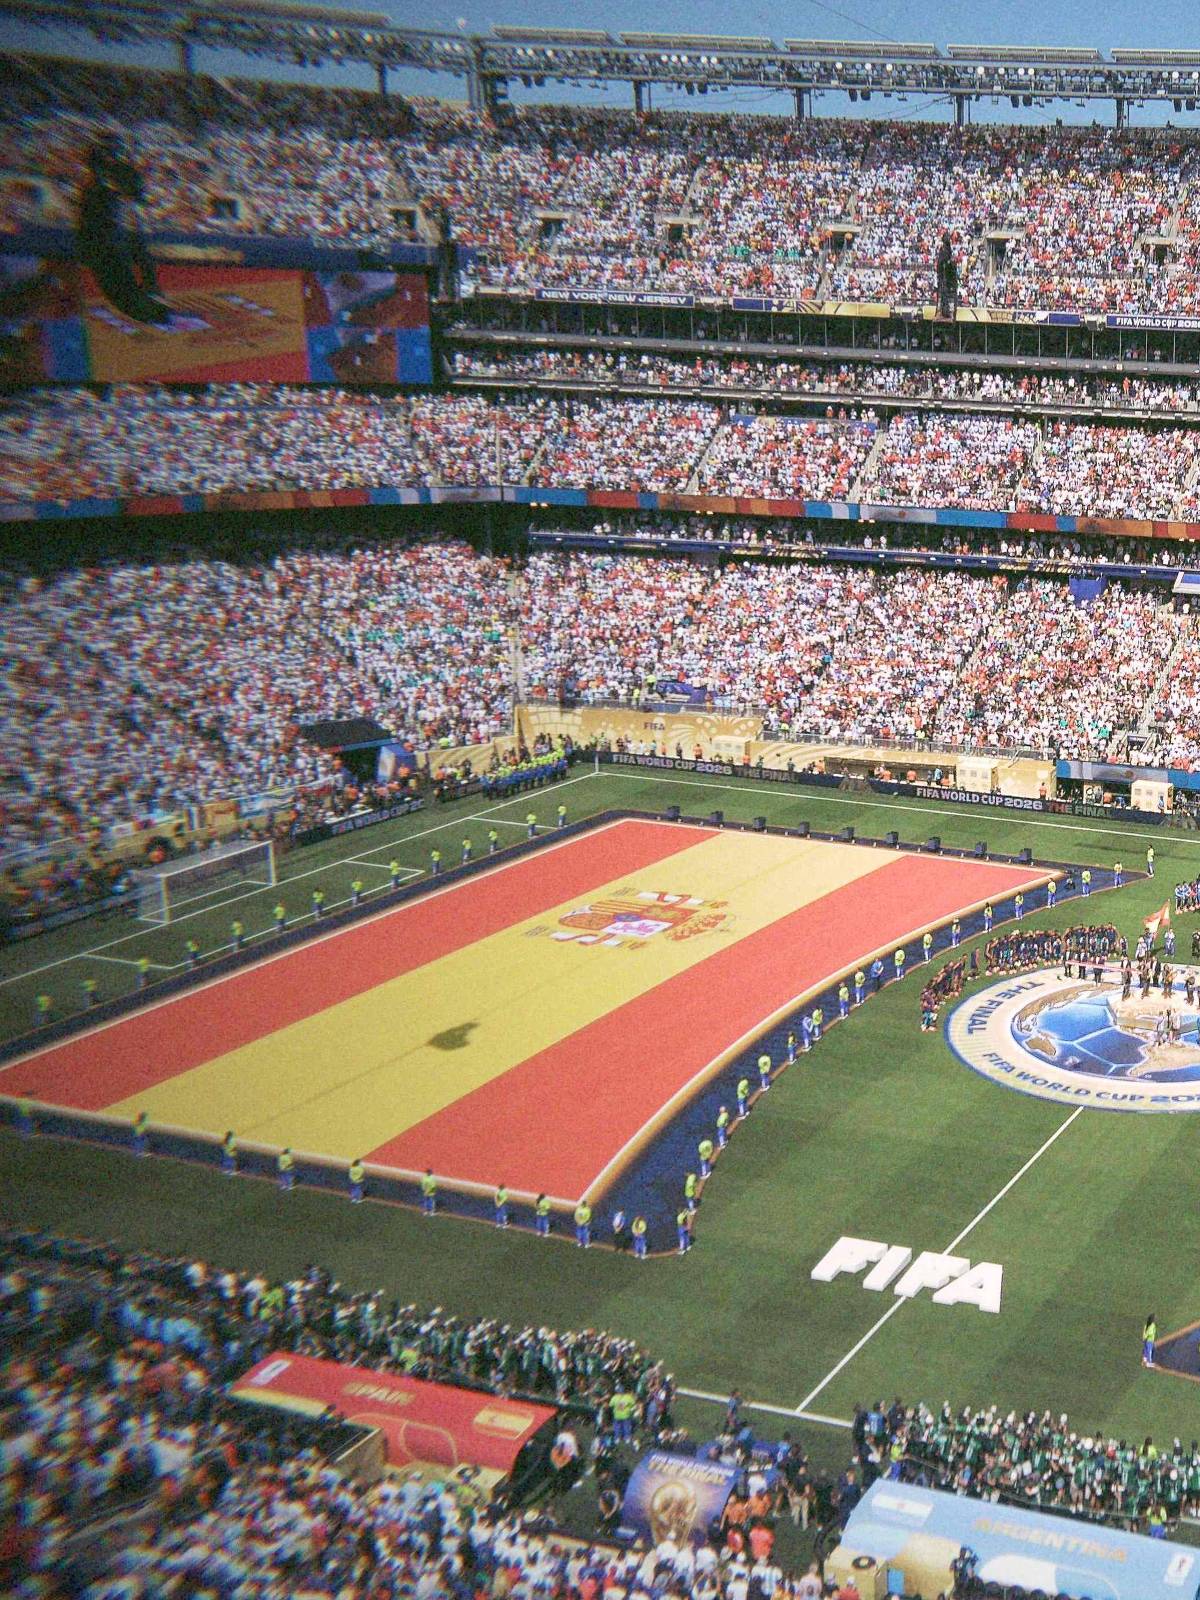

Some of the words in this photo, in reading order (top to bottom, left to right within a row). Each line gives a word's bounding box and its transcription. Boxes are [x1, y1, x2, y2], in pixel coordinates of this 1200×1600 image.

[541, 290, 570, 299] NEW
[608, 293, 637, 303] NEW
[638, 295, 687, 305] JERSEY
[1116, 317, 1133, 326] FIFA
[1133, 317, 1161, 327] WORLD
[1162, 318, 1177, 328] CUP
[644, 722, 666, 731] FIFA
[613, 754, 636, 766] FIFA
[637, 756, 673, 769] WORLD
[675, 760, 696, 771] CUP
[696, 762, 733, 775] 2026
[917, 787, 940, 799] FIFA
[941, 789, 981, 804] WORLD
[982, 794, 1003, 806] CUP
[1004, 799, 1043, 811] 2026
[1050, 801, 1073, 813] THE
[1075, 804, 1111, 818] FINAL
[995, 981, 1045, 999] THE
[967, 999, 1004, 1034] FINAL
[982, 1052, 1016, 1073] FIFA
[1016, 1071, 1091, 1095] WORLD
[1095, 1091, 1145, 1101] CUP
[811, 1236, 1003, 1314] FIFA
